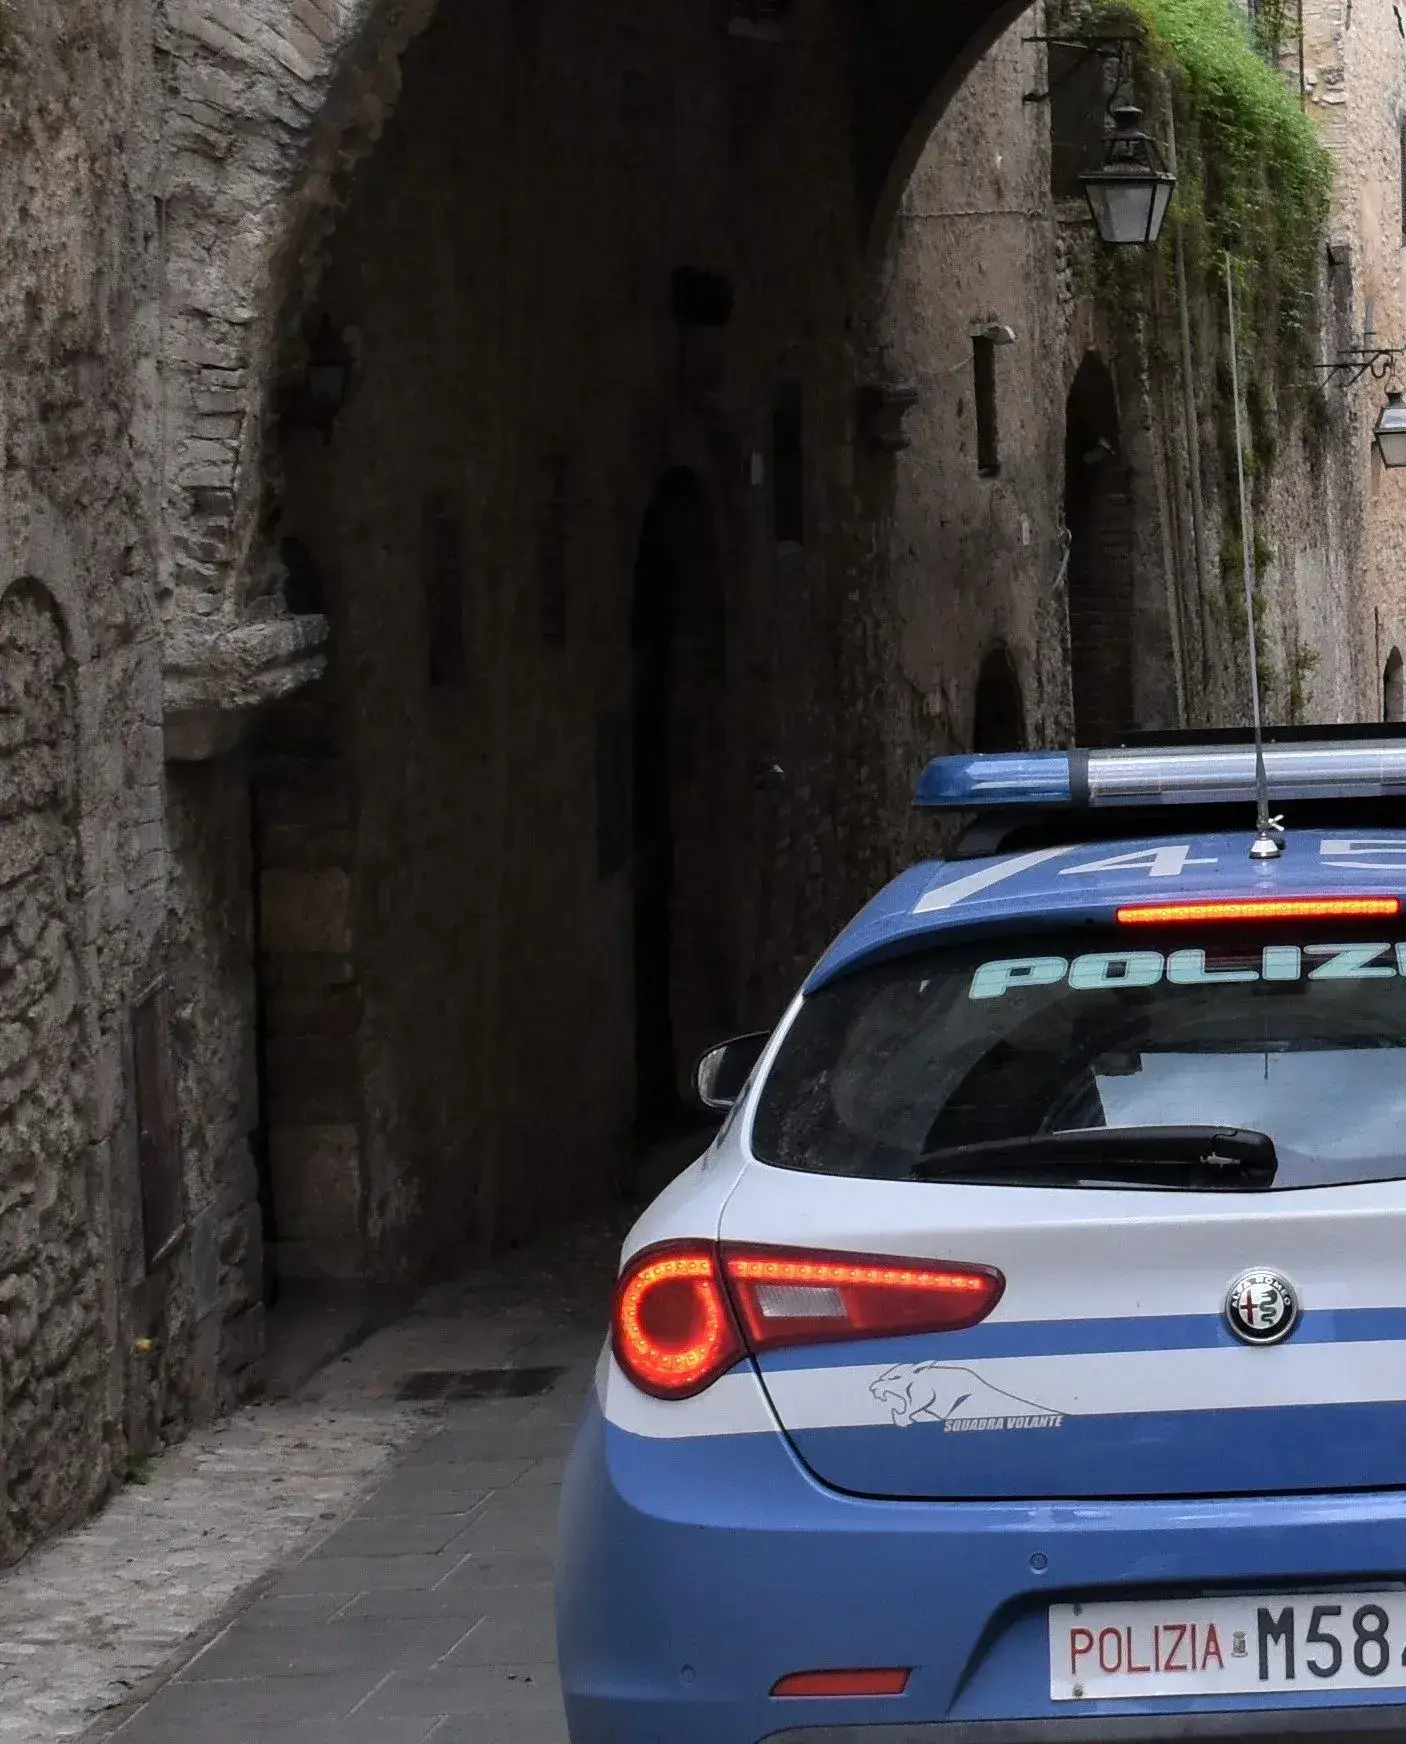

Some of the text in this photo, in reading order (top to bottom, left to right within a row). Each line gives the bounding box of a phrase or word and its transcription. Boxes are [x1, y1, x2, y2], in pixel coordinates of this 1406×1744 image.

[1255, 1275, 1292, 1306] ROMEO
[943, 1415, 1063, 1432] SQUADRA VOLANTE
[1069, 1623, 1224, 1675] POLIZIA
